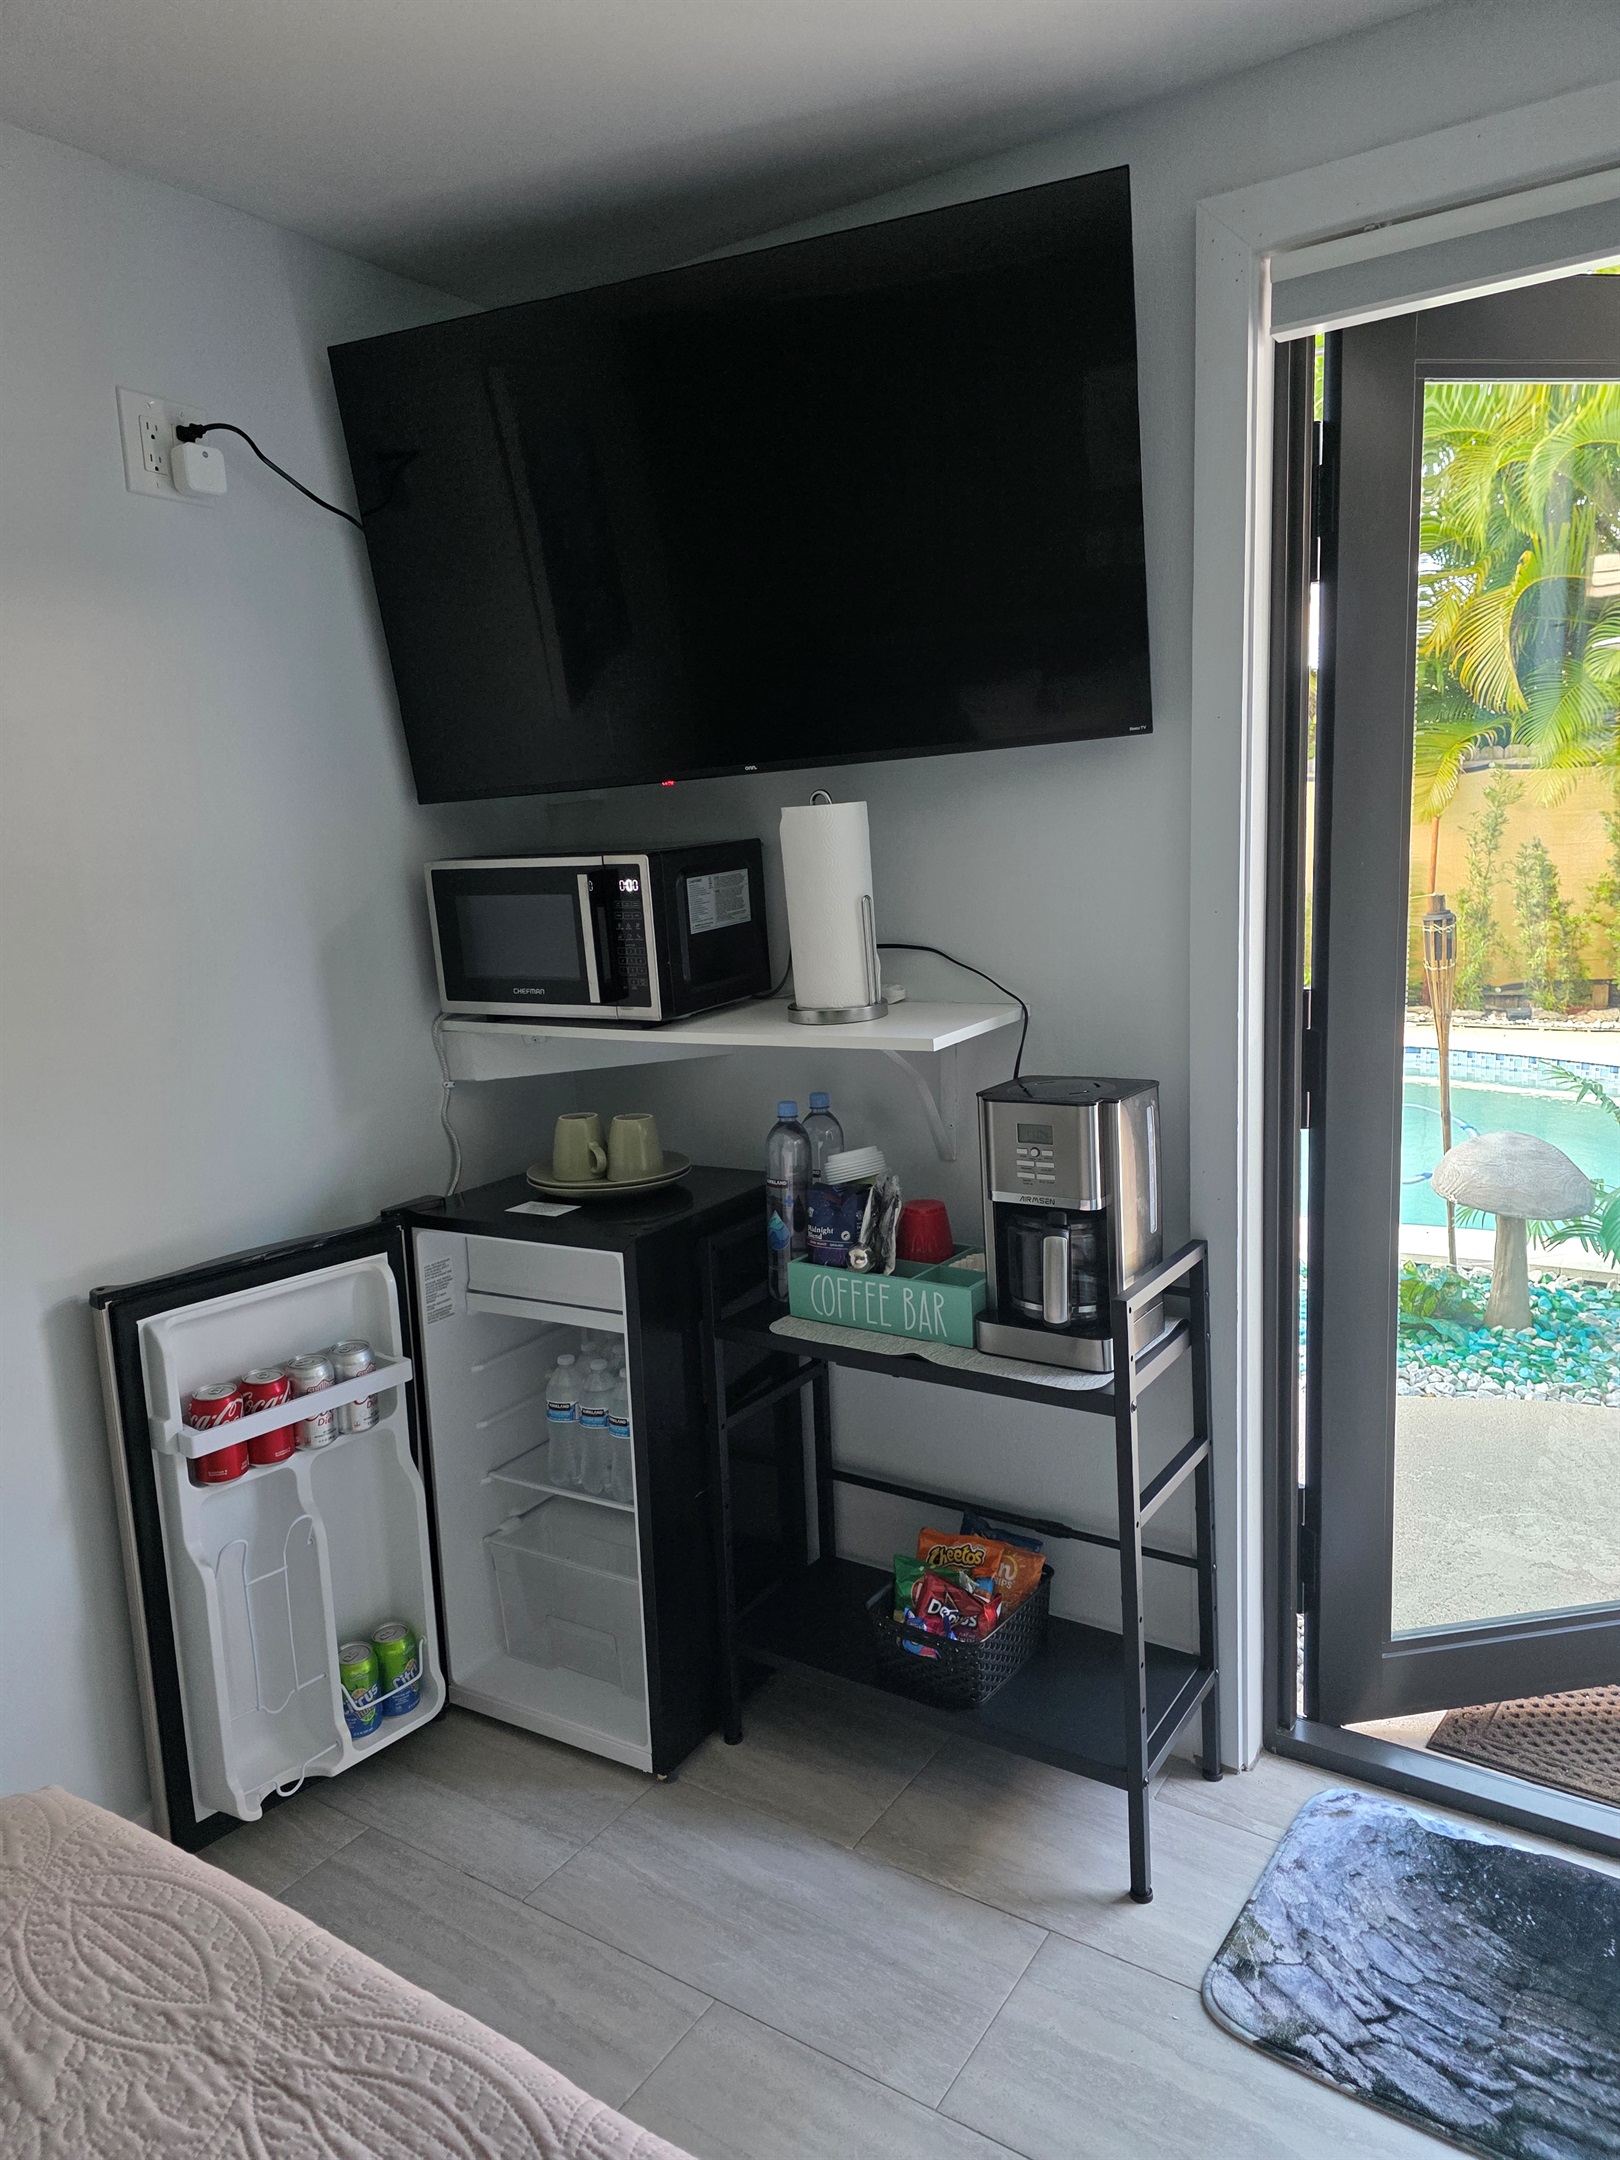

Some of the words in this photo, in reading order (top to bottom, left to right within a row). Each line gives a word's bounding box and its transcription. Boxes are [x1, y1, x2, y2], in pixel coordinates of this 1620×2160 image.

[513, 987, 546, 995] CHEFMAN
[1019, 1196, 1056, 1206] AIRMSEN
[810, 1273, 892, 1328] COFFEE
[902, 1287, 948, 1338] BAR
[928, 1545, 983, 1566] Cheetos
[994, 1577, 1013, 1590] HIPS
[927, 1598, 978, 1627] Dorios
[392, 1663, 418, 1689] Citr
